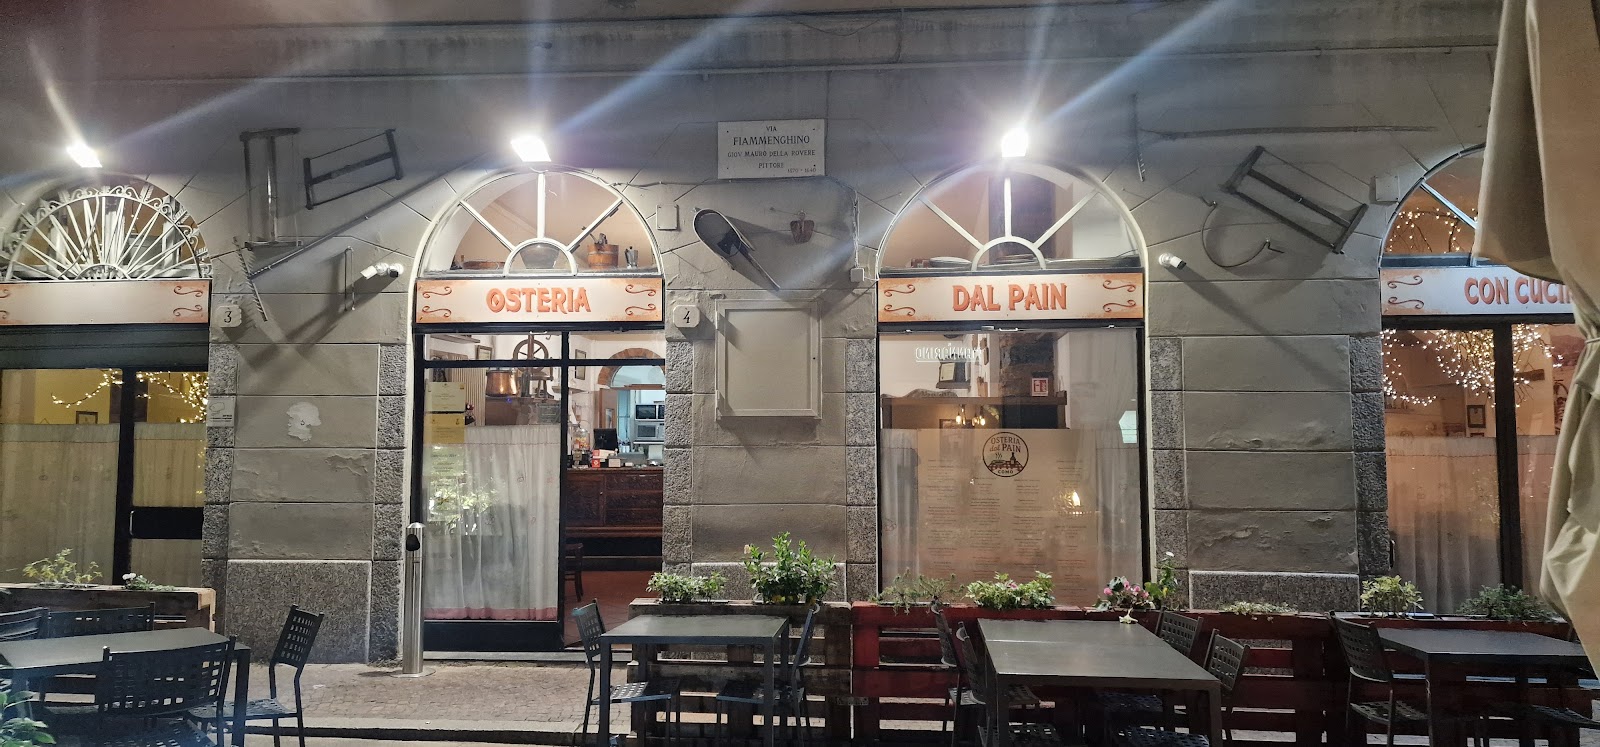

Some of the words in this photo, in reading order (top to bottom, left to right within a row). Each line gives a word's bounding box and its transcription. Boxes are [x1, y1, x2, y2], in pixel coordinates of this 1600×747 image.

[733, 135, 810, 146] FIAMMENGHINO
[952, 284, 1001, 311] DAL
[1008, 283, 1067, 311] PAIN
[1464, 277, 1509, 305] CON
[486, 287, 591, 314] OSTERIA
[224, 311, 232, 323] 3
[683, 311, 690, 323] 4
[991, 436, 1021, 445] OSTERIA
[1002, 443, 1021, 453] PAIN
